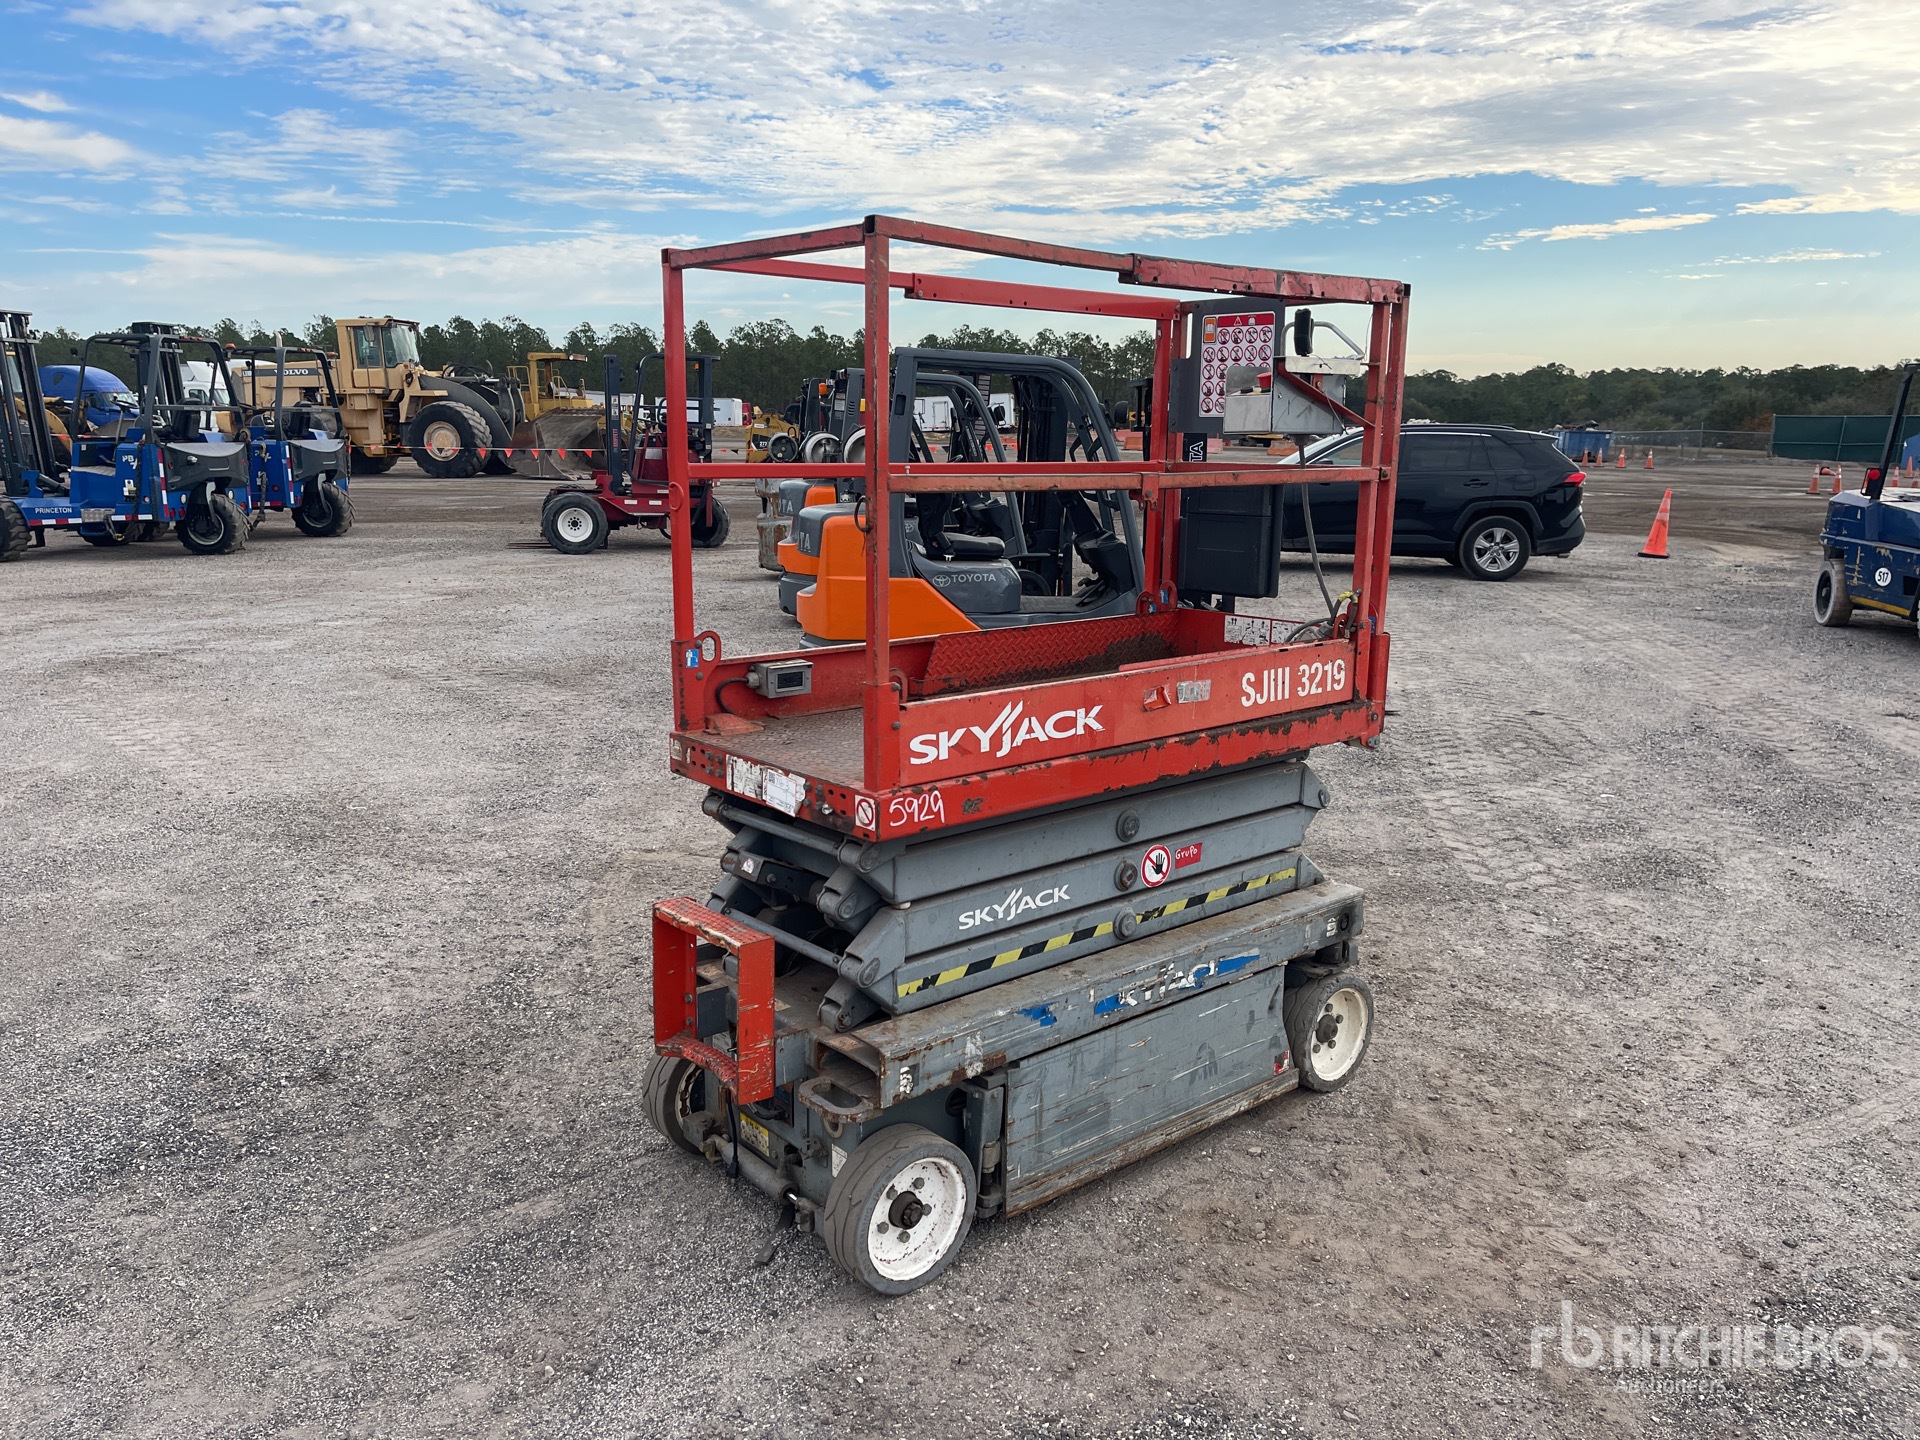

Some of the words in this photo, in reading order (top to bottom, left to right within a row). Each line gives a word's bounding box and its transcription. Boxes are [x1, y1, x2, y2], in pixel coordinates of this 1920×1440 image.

[951, 573, 997, 583] TOYOTA
[1877, 570, 1889, 583] 517
[1297, 659, 1346, 698] 3219
[909, 699, 1106, 766] SKYJACK
[889, 790, 945, 827] 5929
[958, 884, 1071, 930] SKYJACK
